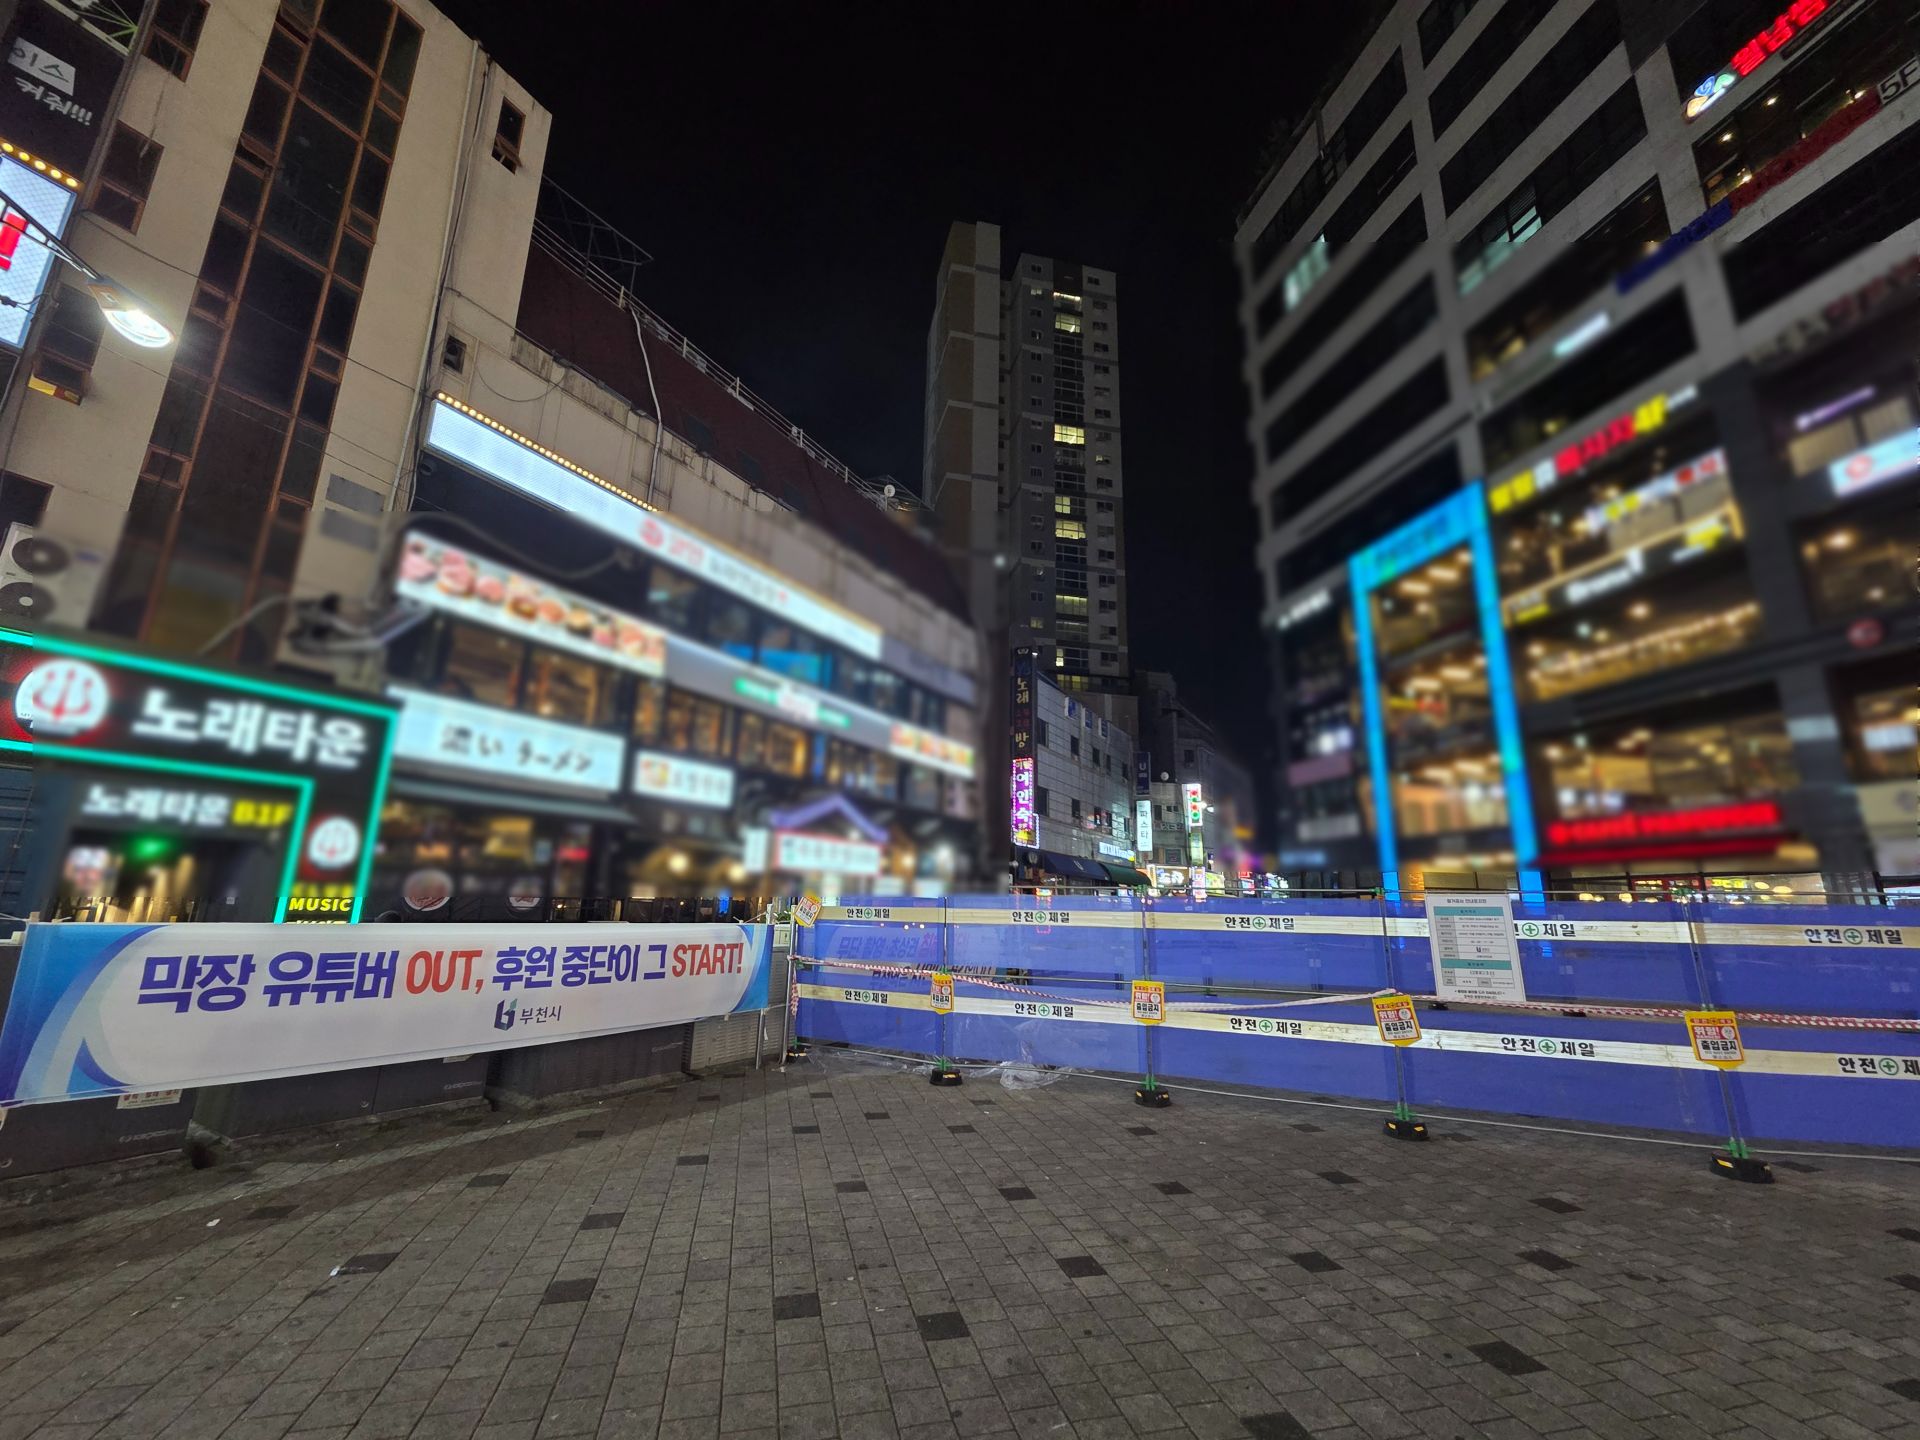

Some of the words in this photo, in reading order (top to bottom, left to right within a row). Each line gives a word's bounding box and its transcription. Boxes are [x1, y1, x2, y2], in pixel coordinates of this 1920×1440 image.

[1879, 59, 1920, 101] 5F
[132, 688, 368, 770] 노래타운
[288, 896, 352, 912] MUSIC
[846, 908, 864, 919] 안전
[874, 908, 890, 919] 제일
[1012, 911, 1034, 923] 안전
[1048, 911, 1070, 924] 제일
[1224, 916, 1251, 930] 안전
[1268, 916, 1296, 930] 제일
[1542, 922, 1577, 938] 제일
[1804, 928, 1843, 944] 안전
[1866, 928, 1904, 945] 제일
[137, 954, 256, 1013] 막장
[262, 950, 400, 1007] 유튜버
[405, 949, 484, 995] OUT,
[492, 946, 558, 992] 후원
[643, 944, 668, 981] 그
[671, 942, 745, 978] START!
[845, 990, 862, 1003] 안전
[872, 992, 888, 1004] 제일
[519, 1005, 562, 1025] 부천시
[1014, 1003, 1038, 1016] 안전
[1051, 1005, 1075, 1018] 제일
[1230, 1017, 1257, 1031] 안전
[1275, 1021, 1302, 1036] 제일
[1501, 1036, 1536, 1053] 안전
[1560, 1041, 1595, 1057] 제일
[1838, 1057, 1878, 1074] 안전
